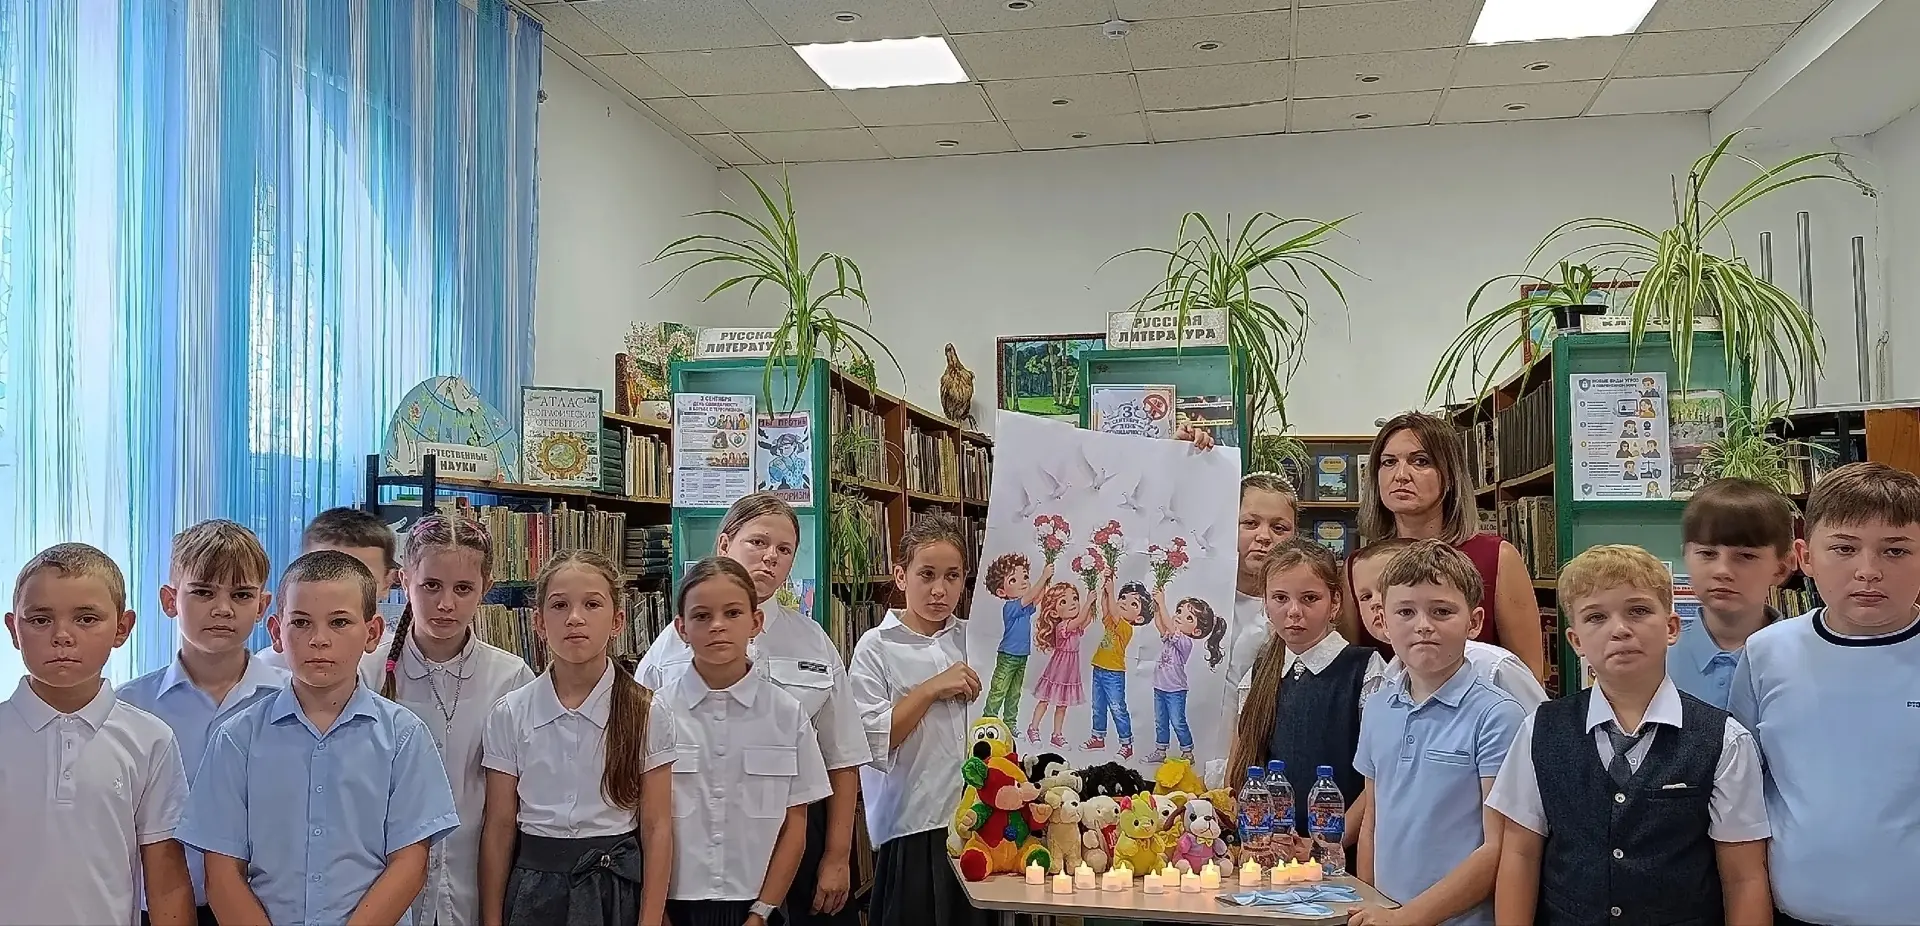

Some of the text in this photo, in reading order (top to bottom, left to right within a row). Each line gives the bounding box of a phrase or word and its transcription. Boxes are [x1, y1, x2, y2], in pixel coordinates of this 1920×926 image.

[720, 331, 776, 341] РУССКА
[1118, 328, 1216, 343] ЛИТЕРАУРА
[705, 341, 793, 352] ЛИТЕРАТУА
[540, 396, 584, 408] АТЛАС
[1122, 406, 1133, 418] 3
[535, 419, 588, 428] ОТКРЫТИЙ
[758, 418, 807, 427] МЫ ПРОТИВ
[427, 448, 488, 461] ЕСТЕСТВЕННЫЕ
[440, 460, 477, 472] НАУКИ
